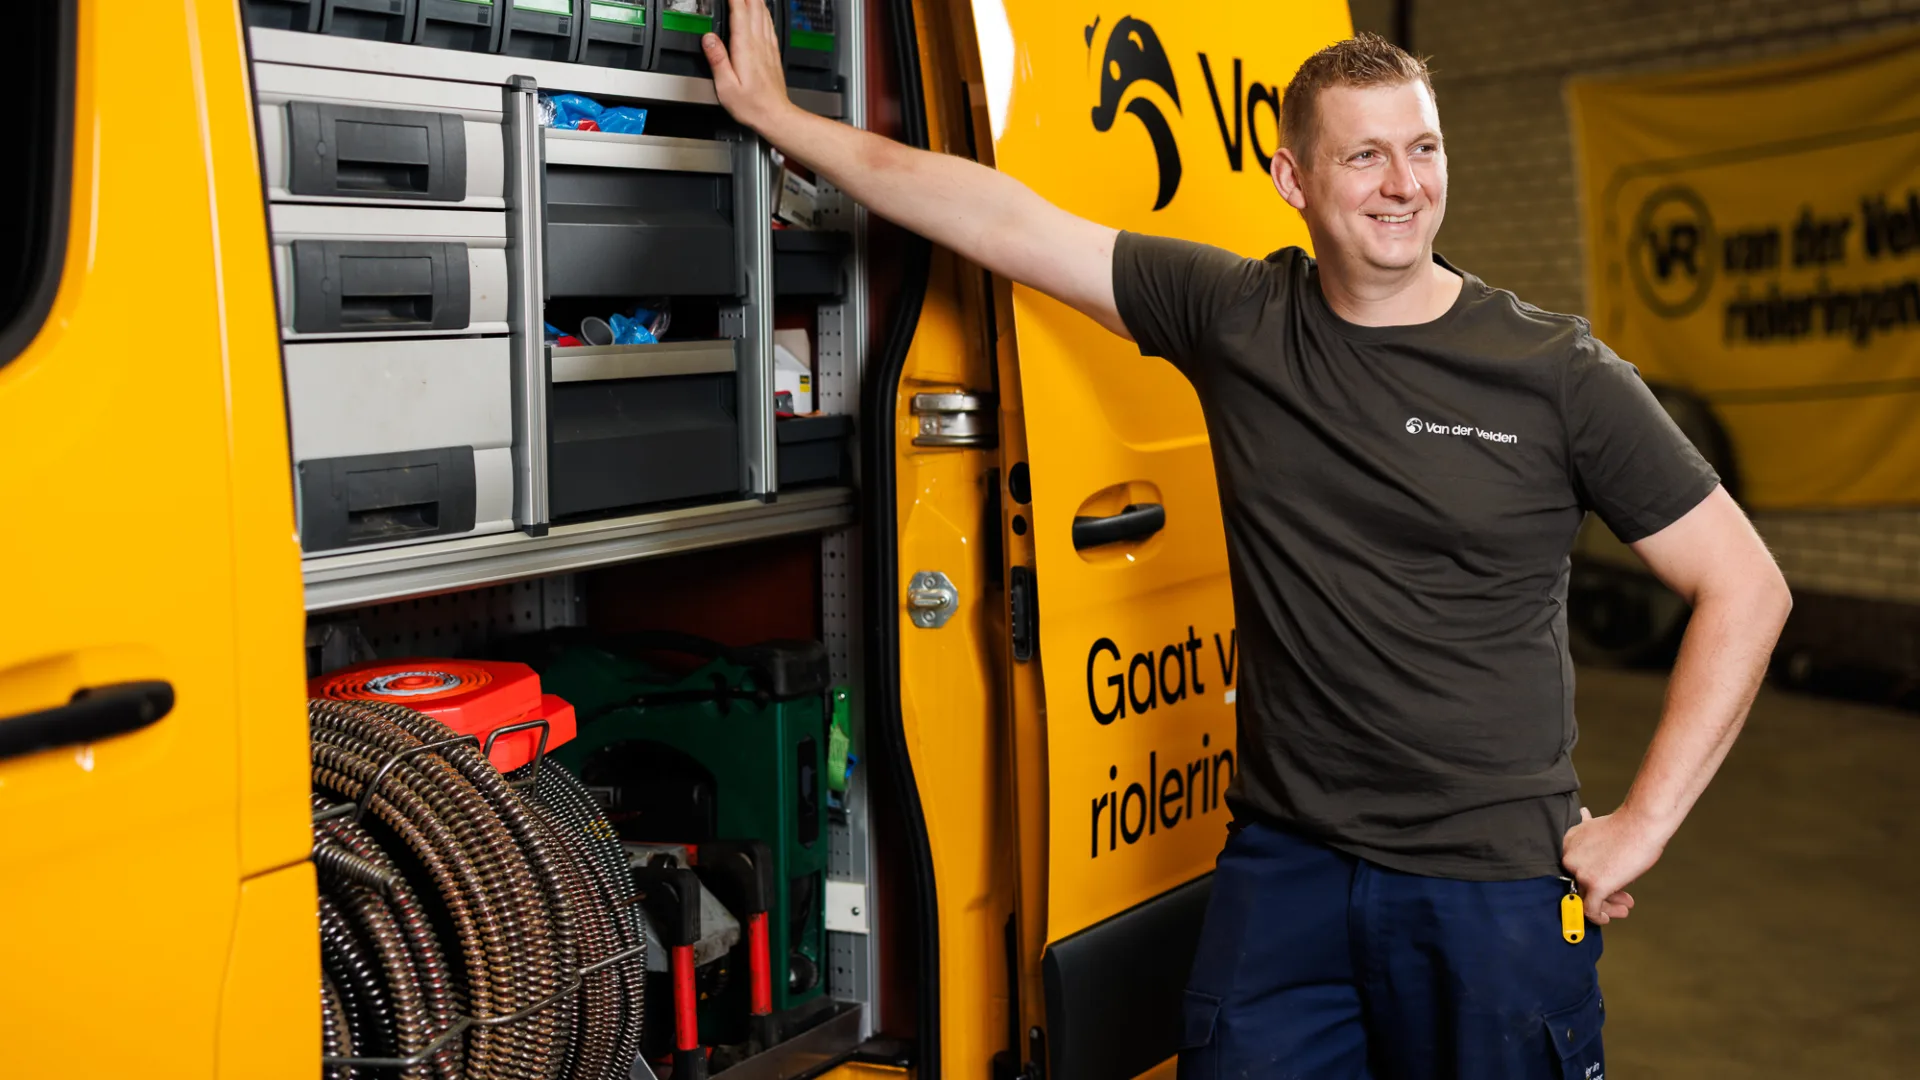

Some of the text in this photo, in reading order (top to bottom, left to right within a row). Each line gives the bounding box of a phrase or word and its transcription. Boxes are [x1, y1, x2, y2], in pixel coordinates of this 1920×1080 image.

[1648, 221, 1699, 279] VR
[1425, 421, 1518, 444] Van der Velden
[1087, 625, 1204, 725] Gaat
